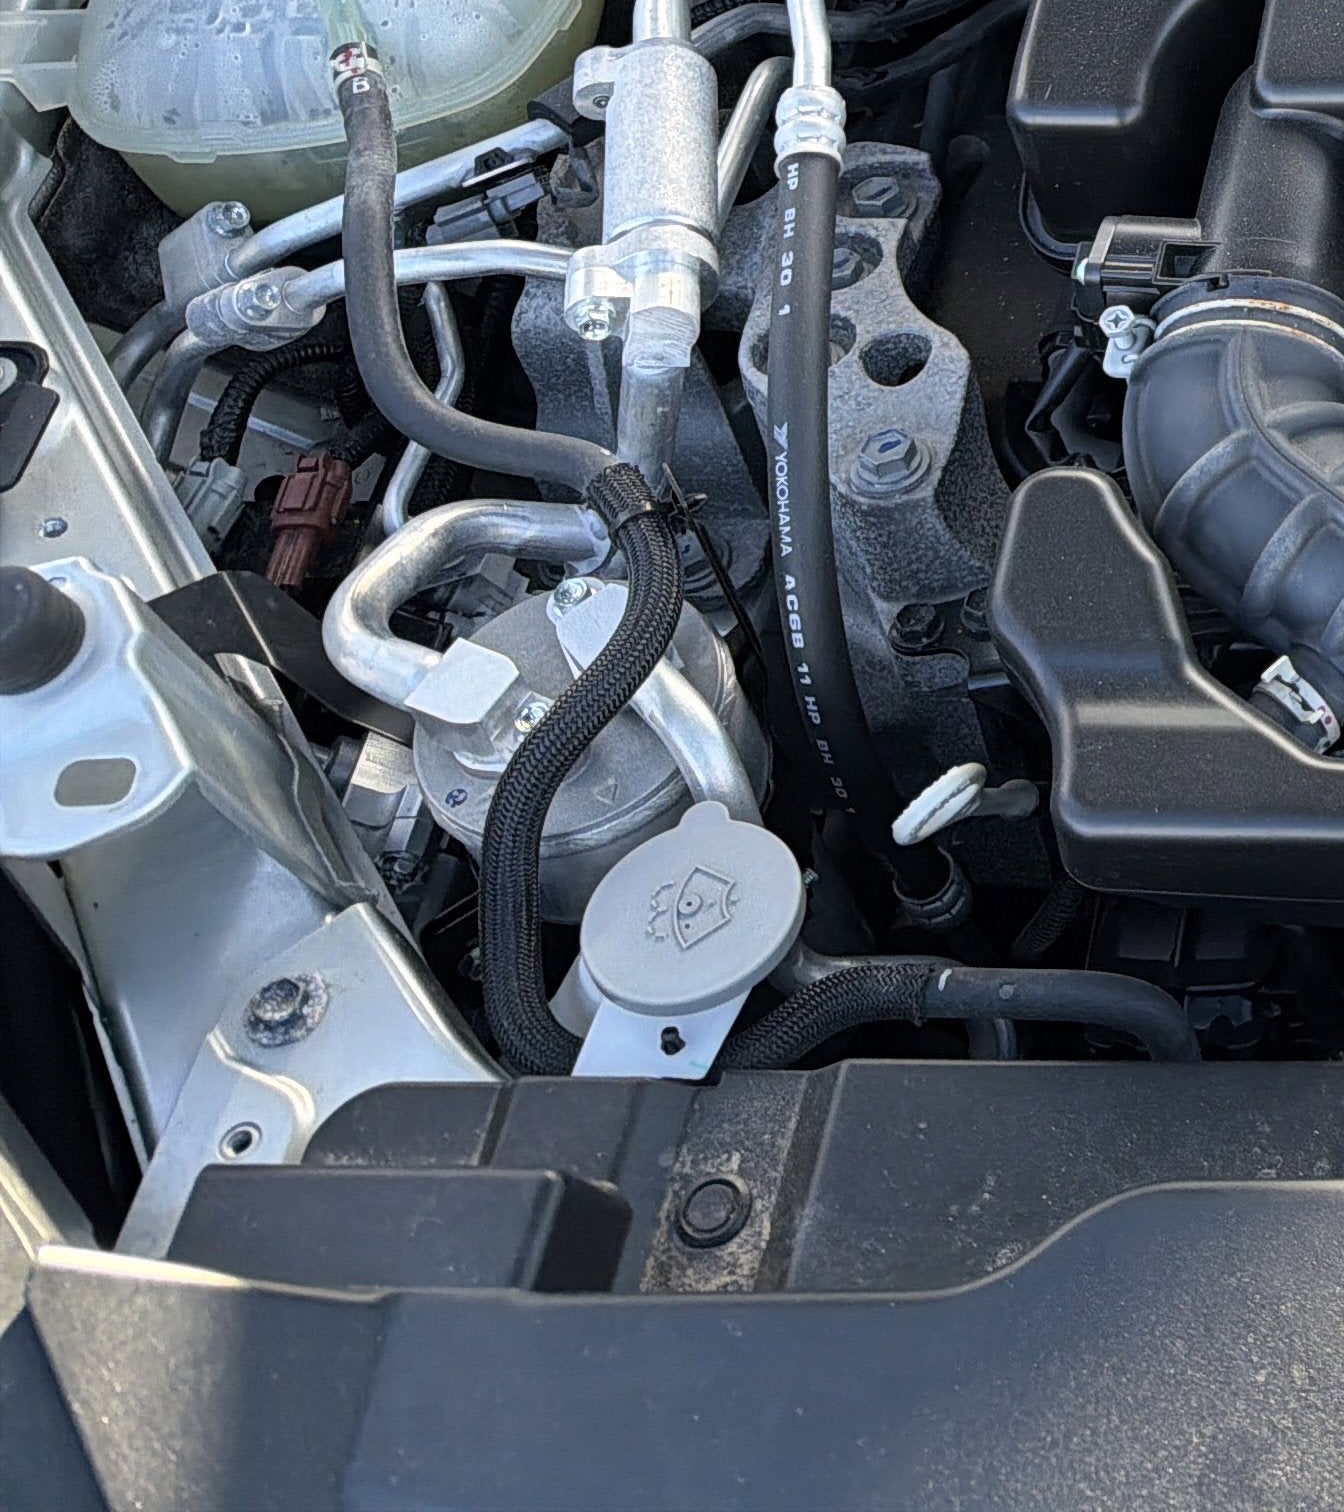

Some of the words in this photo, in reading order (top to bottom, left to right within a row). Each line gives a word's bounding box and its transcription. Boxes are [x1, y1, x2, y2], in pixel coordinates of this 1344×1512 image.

[786, 162, 799, 191] HP
[783, 207, 796, 239] BH
[780, 250, 794, 287] 30
[774, 451, 793, 558] YOKOHAMA
[797, 662, 812, 685] 11
[804, 696, 821, 725] HP
[816, 739, 834, 765] BH
